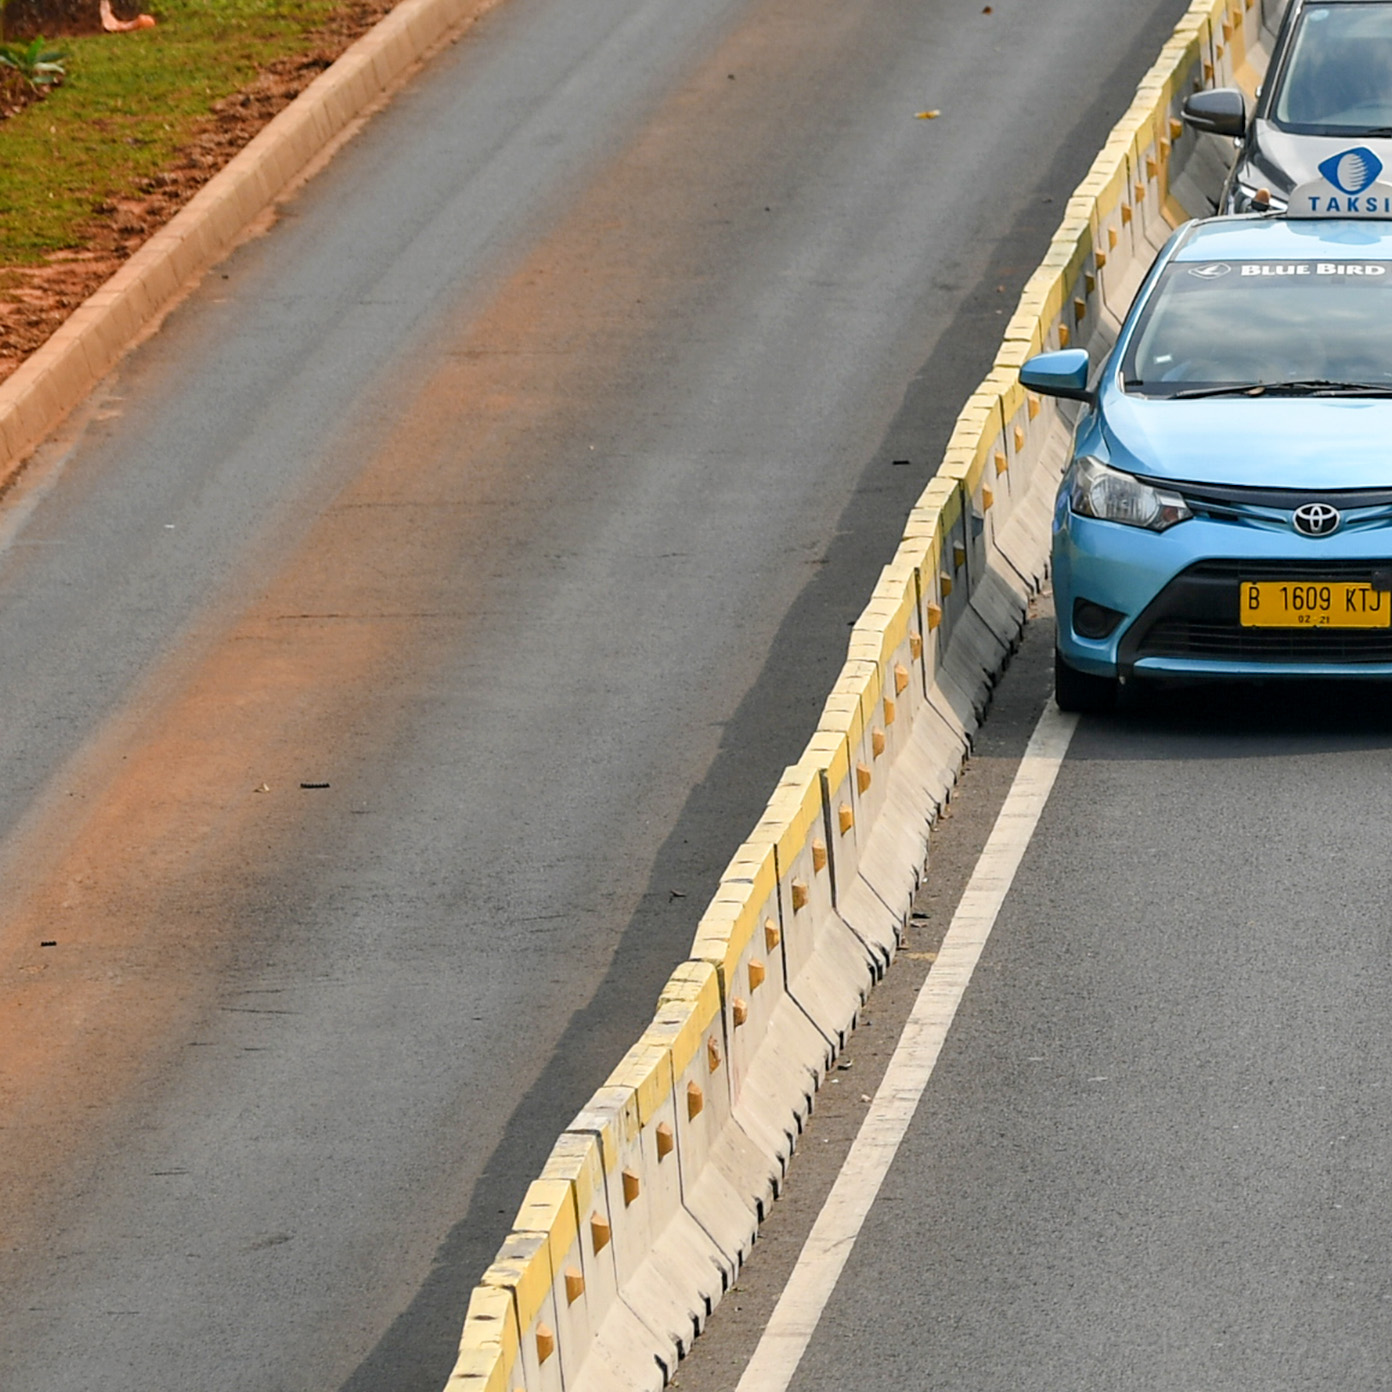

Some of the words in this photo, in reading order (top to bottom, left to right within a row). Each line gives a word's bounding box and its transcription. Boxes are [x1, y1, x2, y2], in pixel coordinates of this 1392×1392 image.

[1308, 196, 1390, 213] TAKSI
[1240, 264, 1311, 276] BLUE
[1316, 262, 1386, 276] BIRD
[1248, 586, 1261, 610] B
[1280, 586, 1331, 611] 1609
[1345, 587, 1382, 612] KTJ
